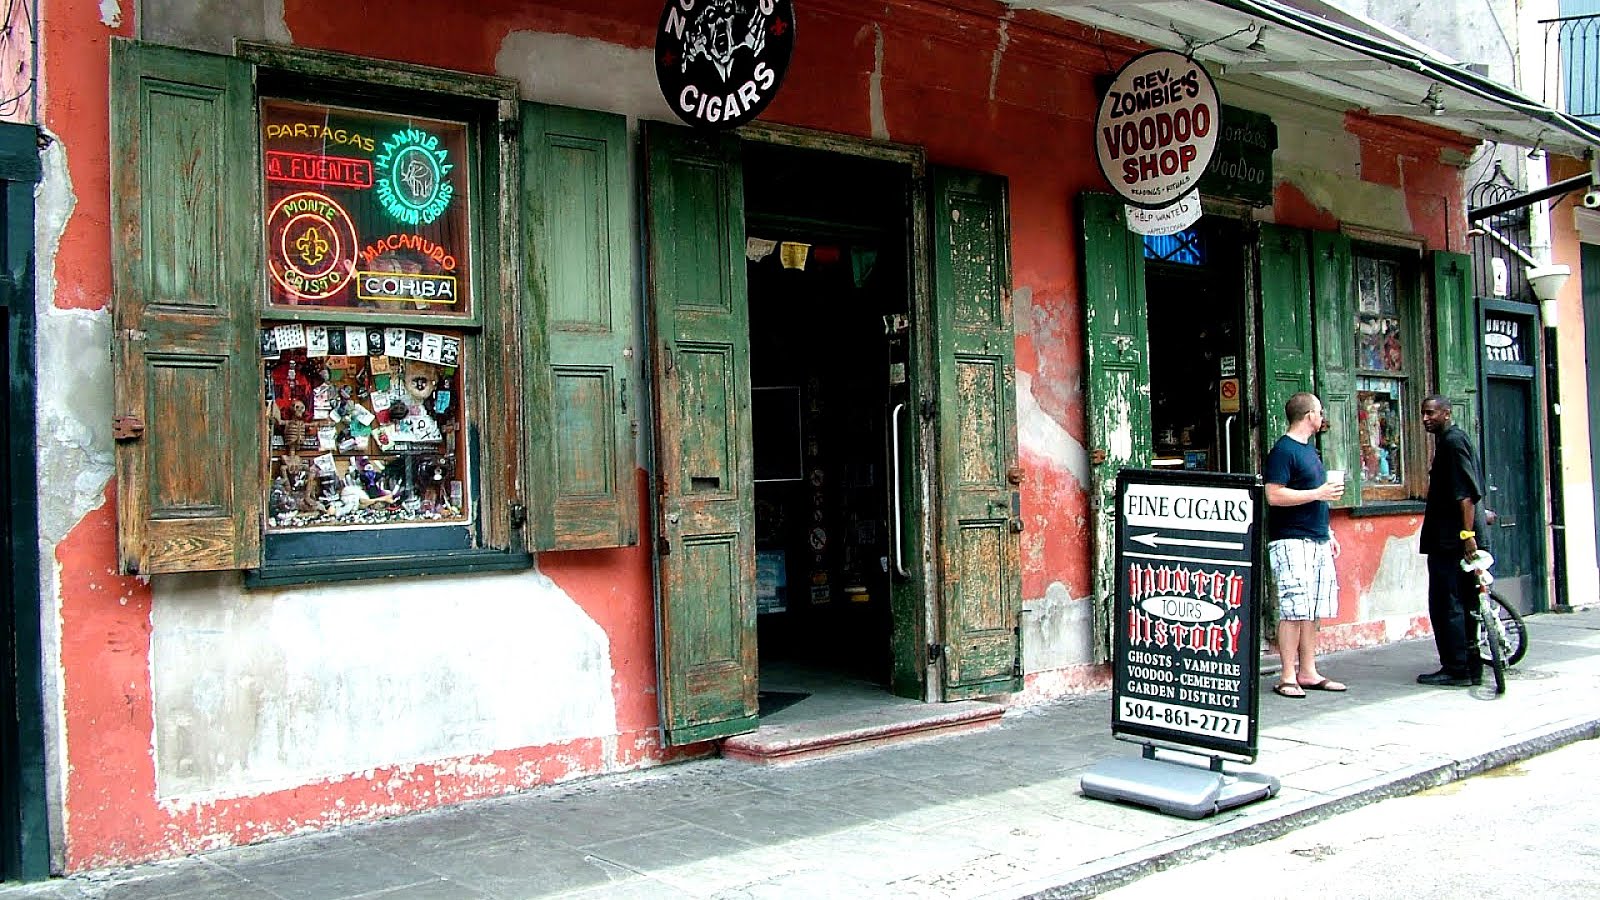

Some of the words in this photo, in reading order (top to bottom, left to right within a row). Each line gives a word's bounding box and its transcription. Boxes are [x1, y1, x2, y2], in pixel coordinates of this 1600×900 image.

[680, 62, 775, 122] CIGARS
[1133, 68, 1174, 91] REV.
[1109, 69, 1199, 119] ZOMBIE'S
[267, 122, 375, 151] PARTAGAS
[1103, 103, 1210, 160] VOODOO
[376, 129, 453, 175] HANNIBAL
[1123, 144, 1197, 184] SHOP
[291, 159, 364, 184] FUENTE
[1166, 176, 1190, 192] RITUALS
[283, 199, 336, 222] MONTE
[422, 182, 453, 224] CIGARS
[1135, 211, 1153, 222] HELP
[361, 234, 456, 271] MACANUDO
[284, 269, 340, 292] CRISTO
[365, 277, 453, 298] COHIBA
[1128, 495, 1169, 517] FINE
[1174, 497, 1247, 522] CIGARS
[1128, 562, 1244, 610] HAUNTED
[1162, 600, 1202, 619] TOURS
[1128, 605, 1243, 659] HISTORY
[1128, 650, 1172, 667] GHOSTS
[1183, 658, 1241, 676] VAMPIRE
[1127, 665, 1174, 683] VOODOO
[1180, 673, 1241, 692] CEMETERY
[1127, 680, 1175, 698] GARDEN
[1180, 688, 1240, 708] DISTRICT
[1125, 702, 1241, 735] 504-861-2727
